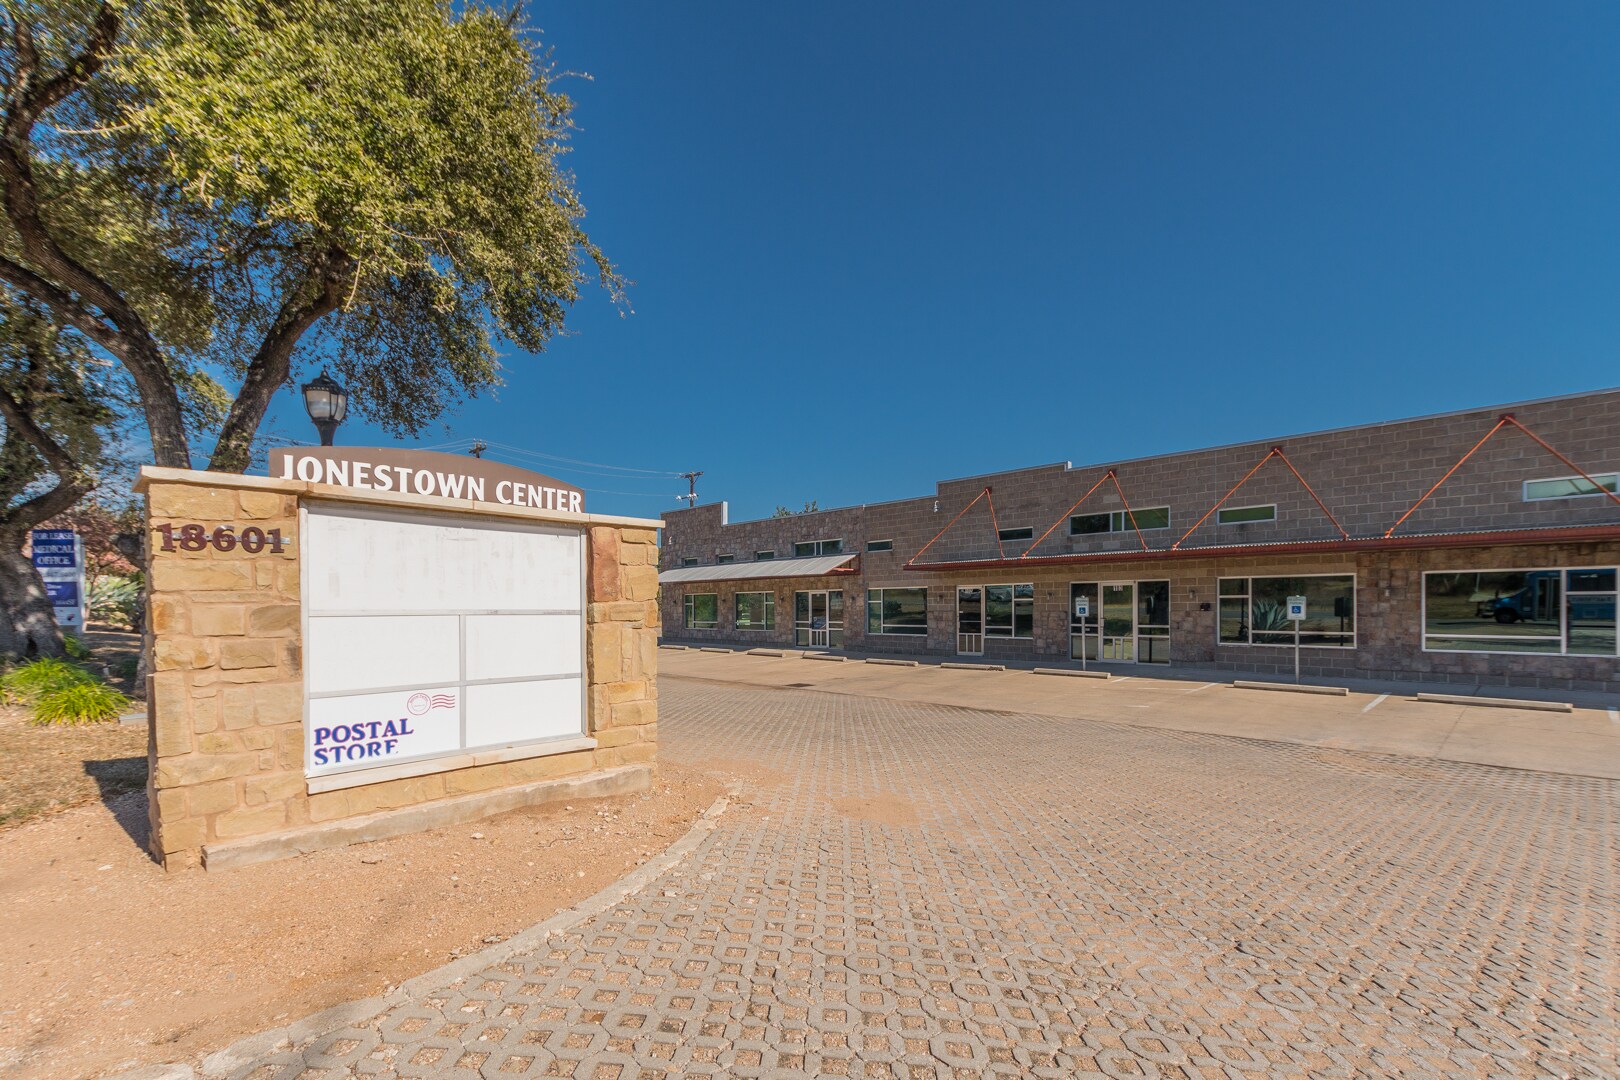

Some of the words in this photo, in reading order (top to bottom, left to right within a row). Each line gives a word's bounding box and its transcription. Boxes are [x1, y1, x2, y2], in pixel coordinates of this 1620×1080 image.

[280, 454, 485, 502] JONESTOWN
[495, 480, 582, 513] CENTER
[33, 532, 48, 540] FOR
[49, 532, 74, 540] LEASE
[33, 544, 74, 554] MEDICAL
[156, 523, 284, 553] 18601
[37, 556, 71, 565] OFFICE
[314, 718, 414, 746] POSTAL
[314, 739, 399, 766] STORE
